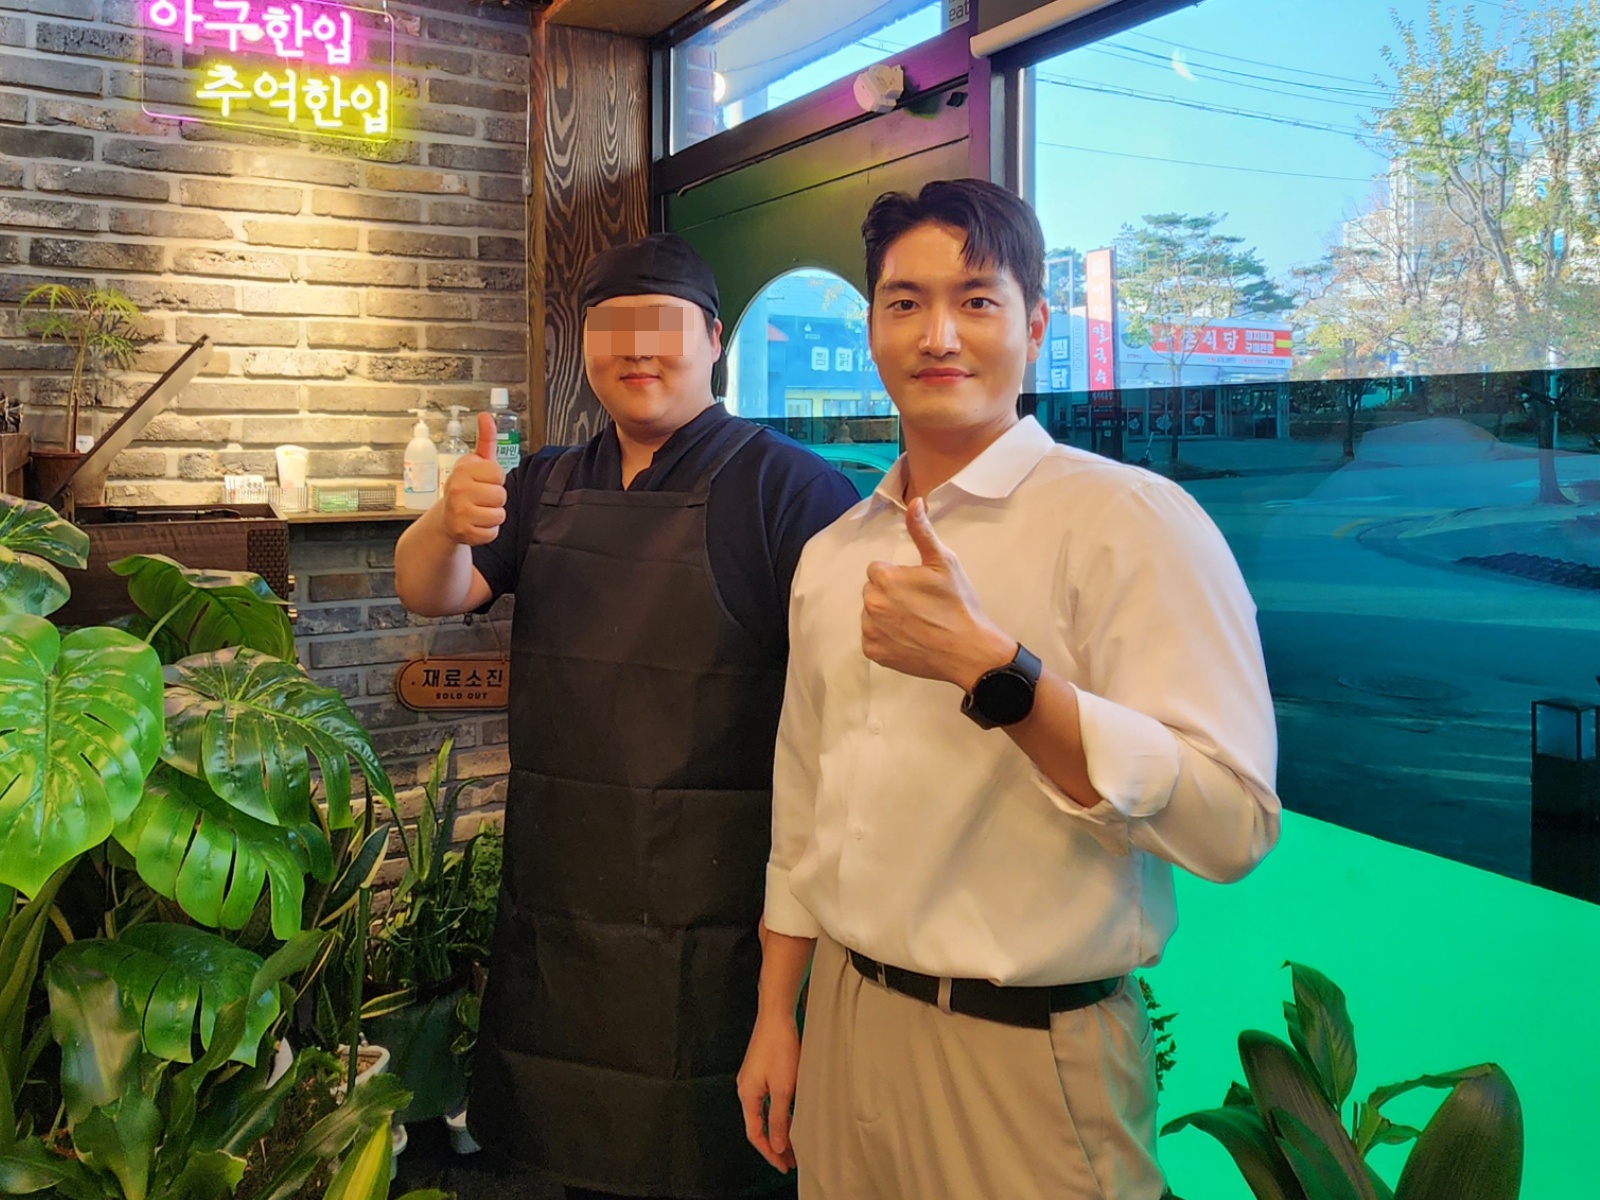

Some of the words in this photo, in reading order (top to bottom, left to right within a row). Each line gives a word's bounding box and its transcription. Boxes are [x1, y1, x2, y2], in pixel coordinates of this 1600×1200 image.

[949, 0, 969, 22] eat
[149, 0, 352, 64] 아구한입
[196, 64, 389, 133] 추억한입
[421, 669, 504, 688] 재료소진
[436, 692, 462, 700] SOLD
[467, 692, 489, 700] OUT
